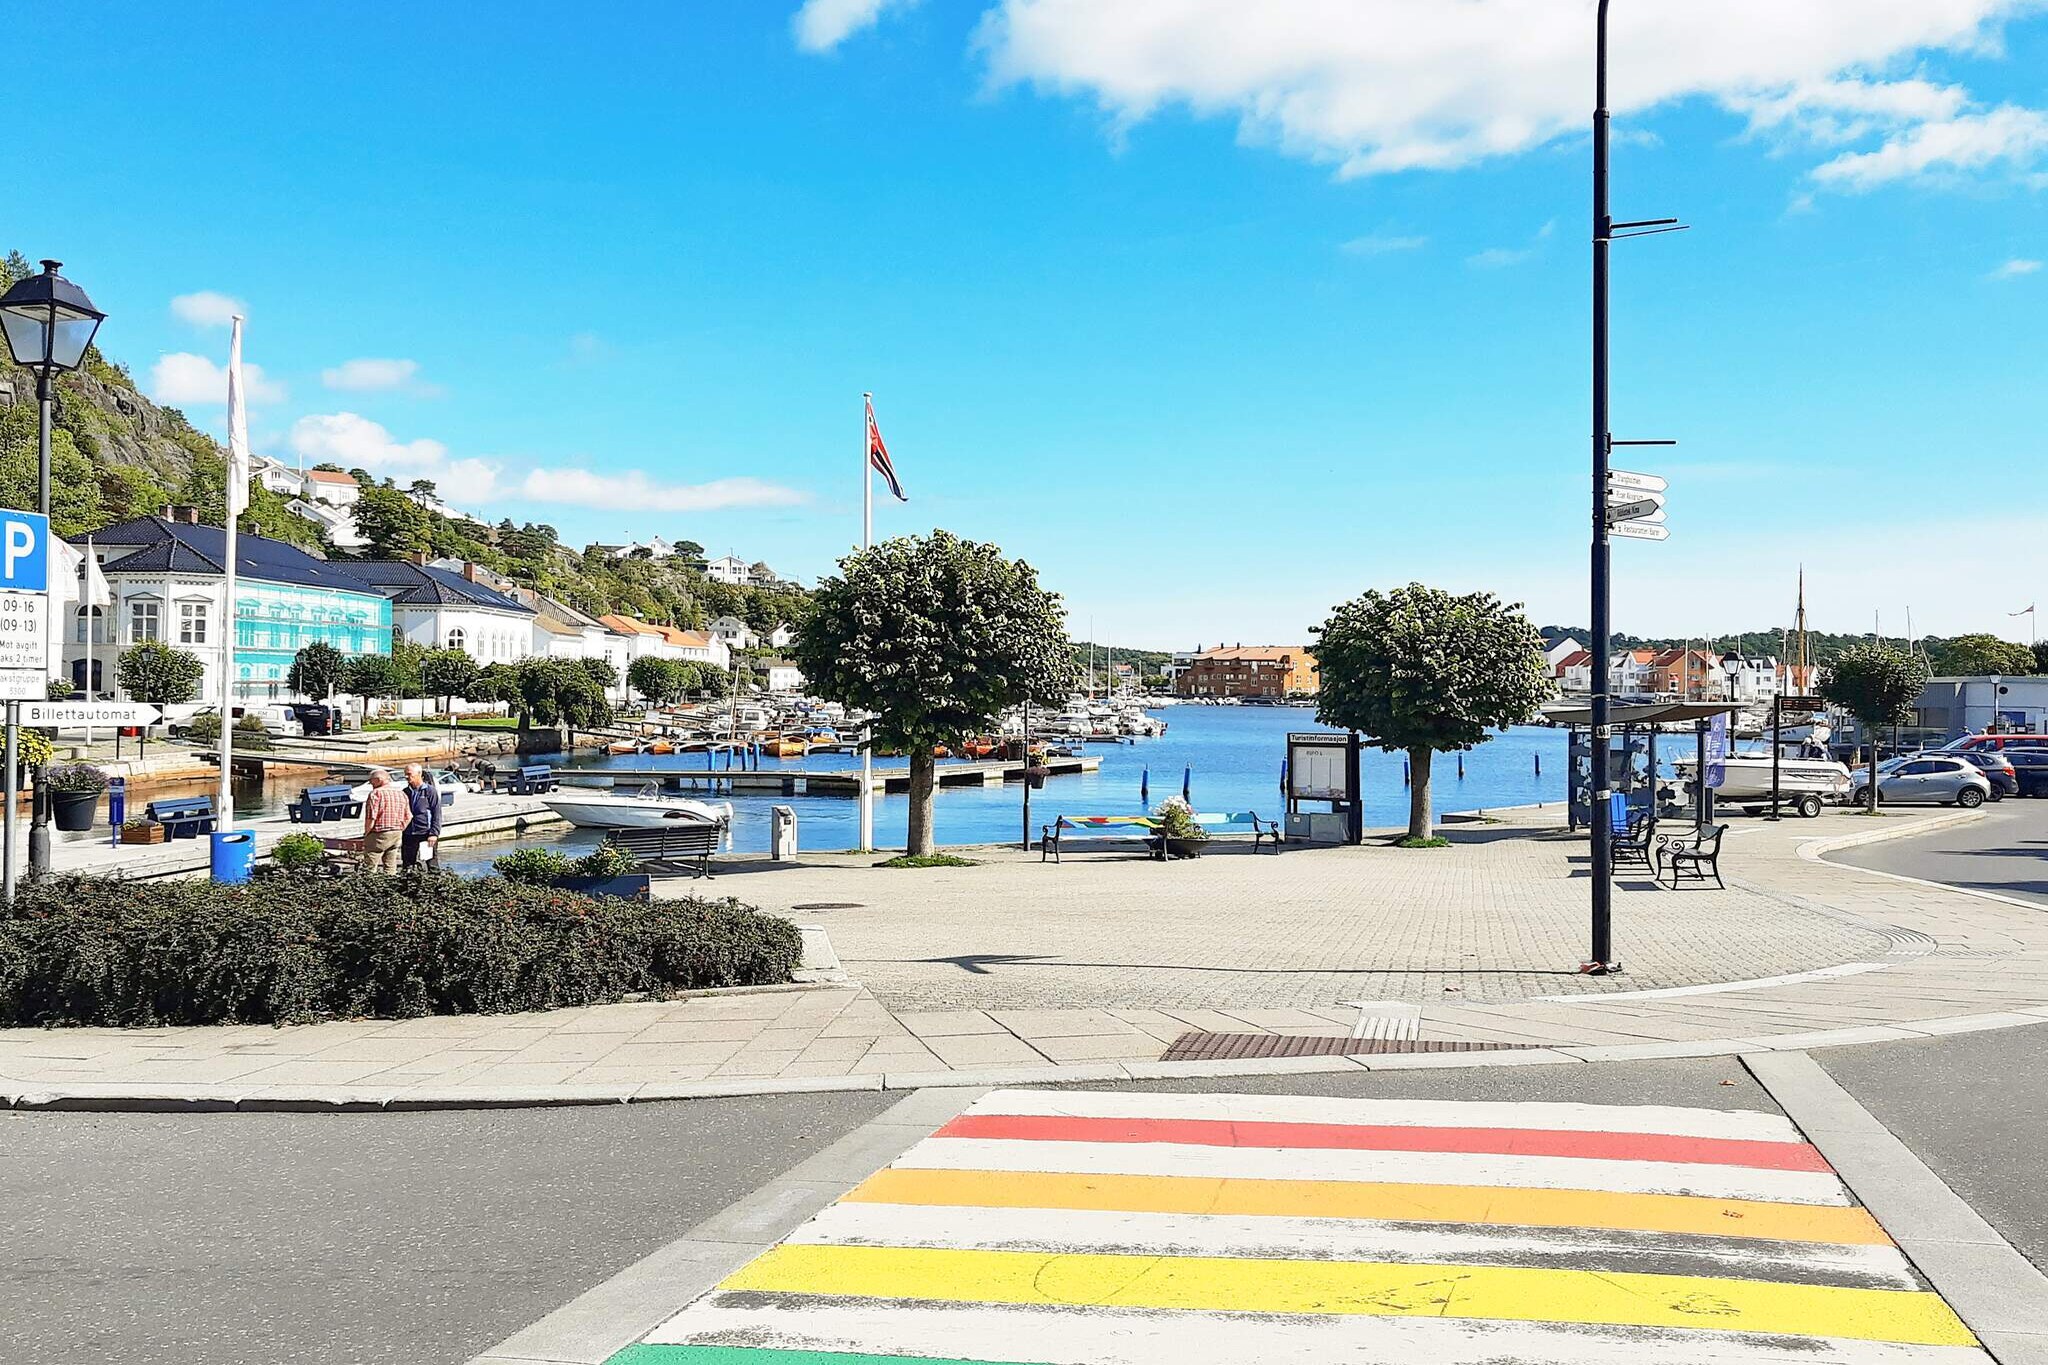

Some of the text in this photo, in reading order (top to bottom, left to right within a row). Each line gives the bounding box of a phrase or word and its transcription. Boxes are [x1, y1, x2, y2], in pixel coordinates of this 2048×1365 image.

[5, 520, 35, 579] P
[3, 599, 35, 613] 09-16
[0, 618, 37, 633] (09-13)
[0, 640, 38, 652] Mot avgift
[0, 653, 42, 664] aks 2 timer
[0, 673, 40, 685] akstgruppe
[31, 707, 137, 720] Billettautomat
[1291, 734, 1347, 743] Turistinformasjon
